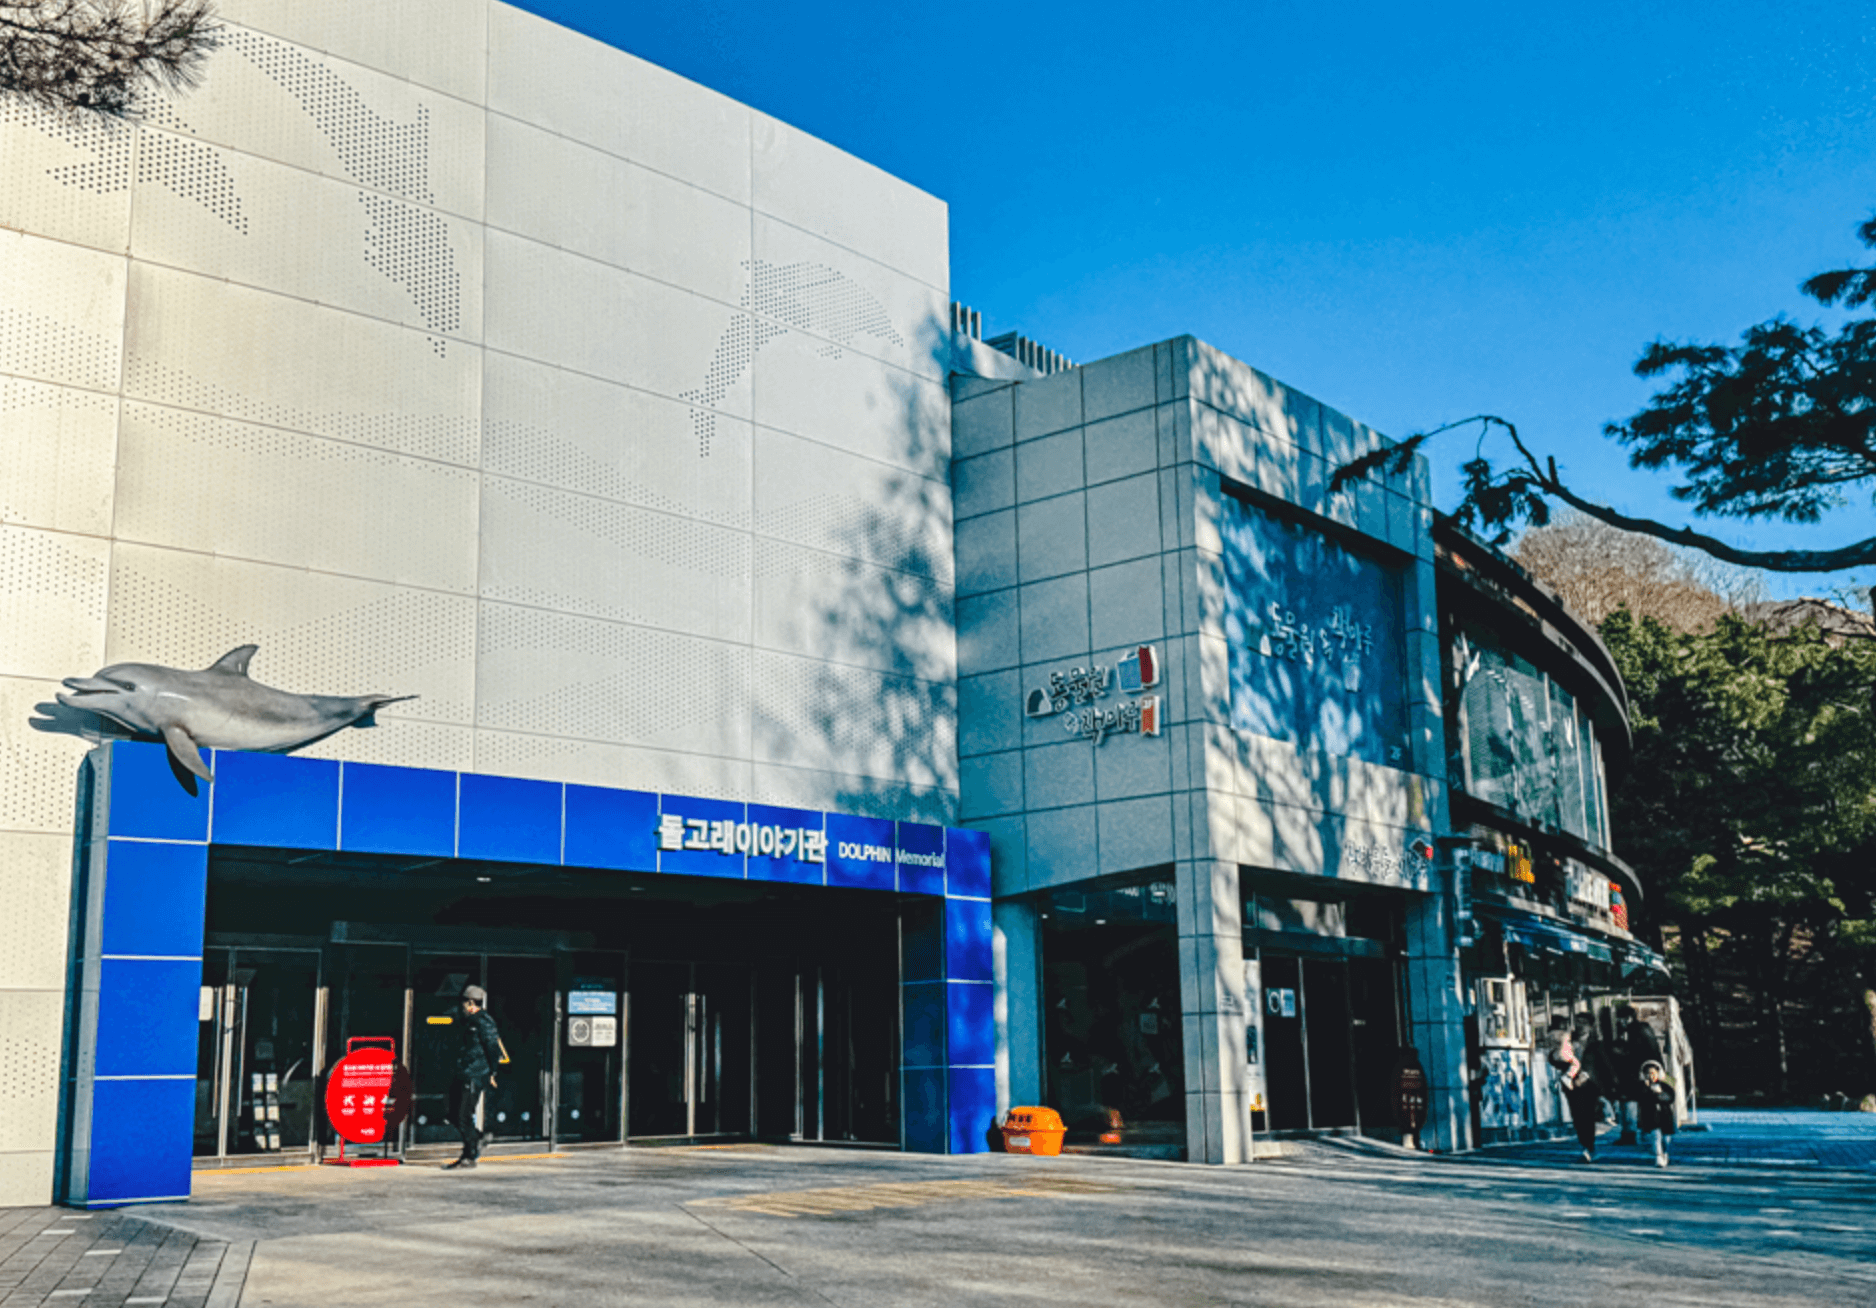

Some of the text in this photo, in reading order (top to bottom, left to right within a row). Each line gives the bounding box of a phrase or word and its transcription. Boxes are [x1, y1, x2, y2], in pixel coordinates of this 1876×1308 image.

[657, 813, 828, 863] 돌고래이야기관
[838, 841, 946, 868] DOLPHIN Memorial
